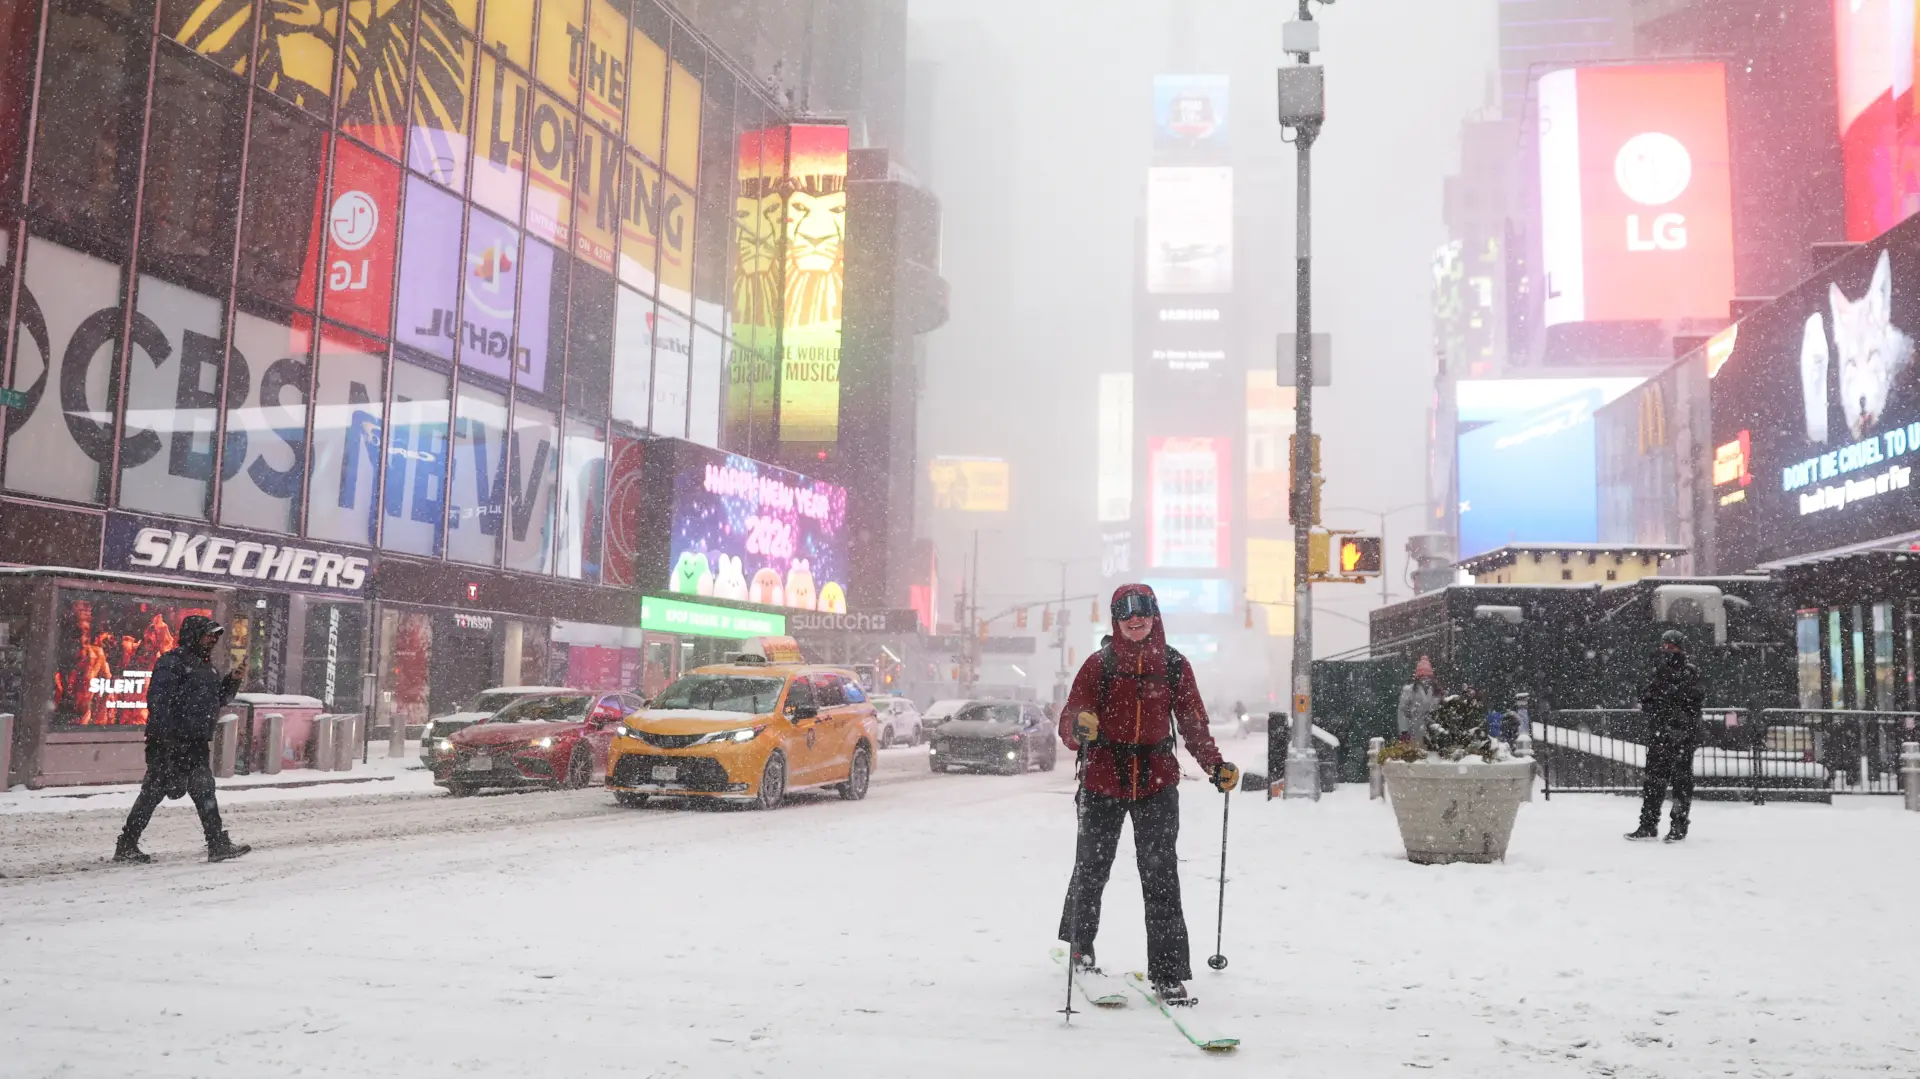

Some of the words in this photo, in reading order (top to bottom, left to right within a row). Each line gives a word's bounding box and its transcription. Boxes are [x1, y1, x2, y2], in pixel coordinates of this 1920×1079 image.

[567, 22, 624, 111] THE
[489, 40, 593, 196] LION
[596, 119, 684, 252] KING
[529, 209, 569, 240] ENTRANCE
[579, 237, 591, 254] ON
[594, 241, 613, 264] 45TH
[1626, 213, 1687, 251] LG
[60, 306, 317, 500] CBS
[1783, 457, 1819, 492] DON'T
[1819, 450, 1839, 480] BE
[1838, 436, 1884, 474] CRUEL
[1883, 427, 1907, 458] TO
[704, 463, 759, 502] HAPPY
[759, 475, 794, 513] NEW
[794, 486, 830, 521] YEAR
[130, 527, 369, 591] SKECHERS
[744, 514, 794, 559] 2026
[791, 612, 868, 633] swatch
[325, 605, 339, 707] SKECHERS
[88, 677, 146, 697] SILENT
